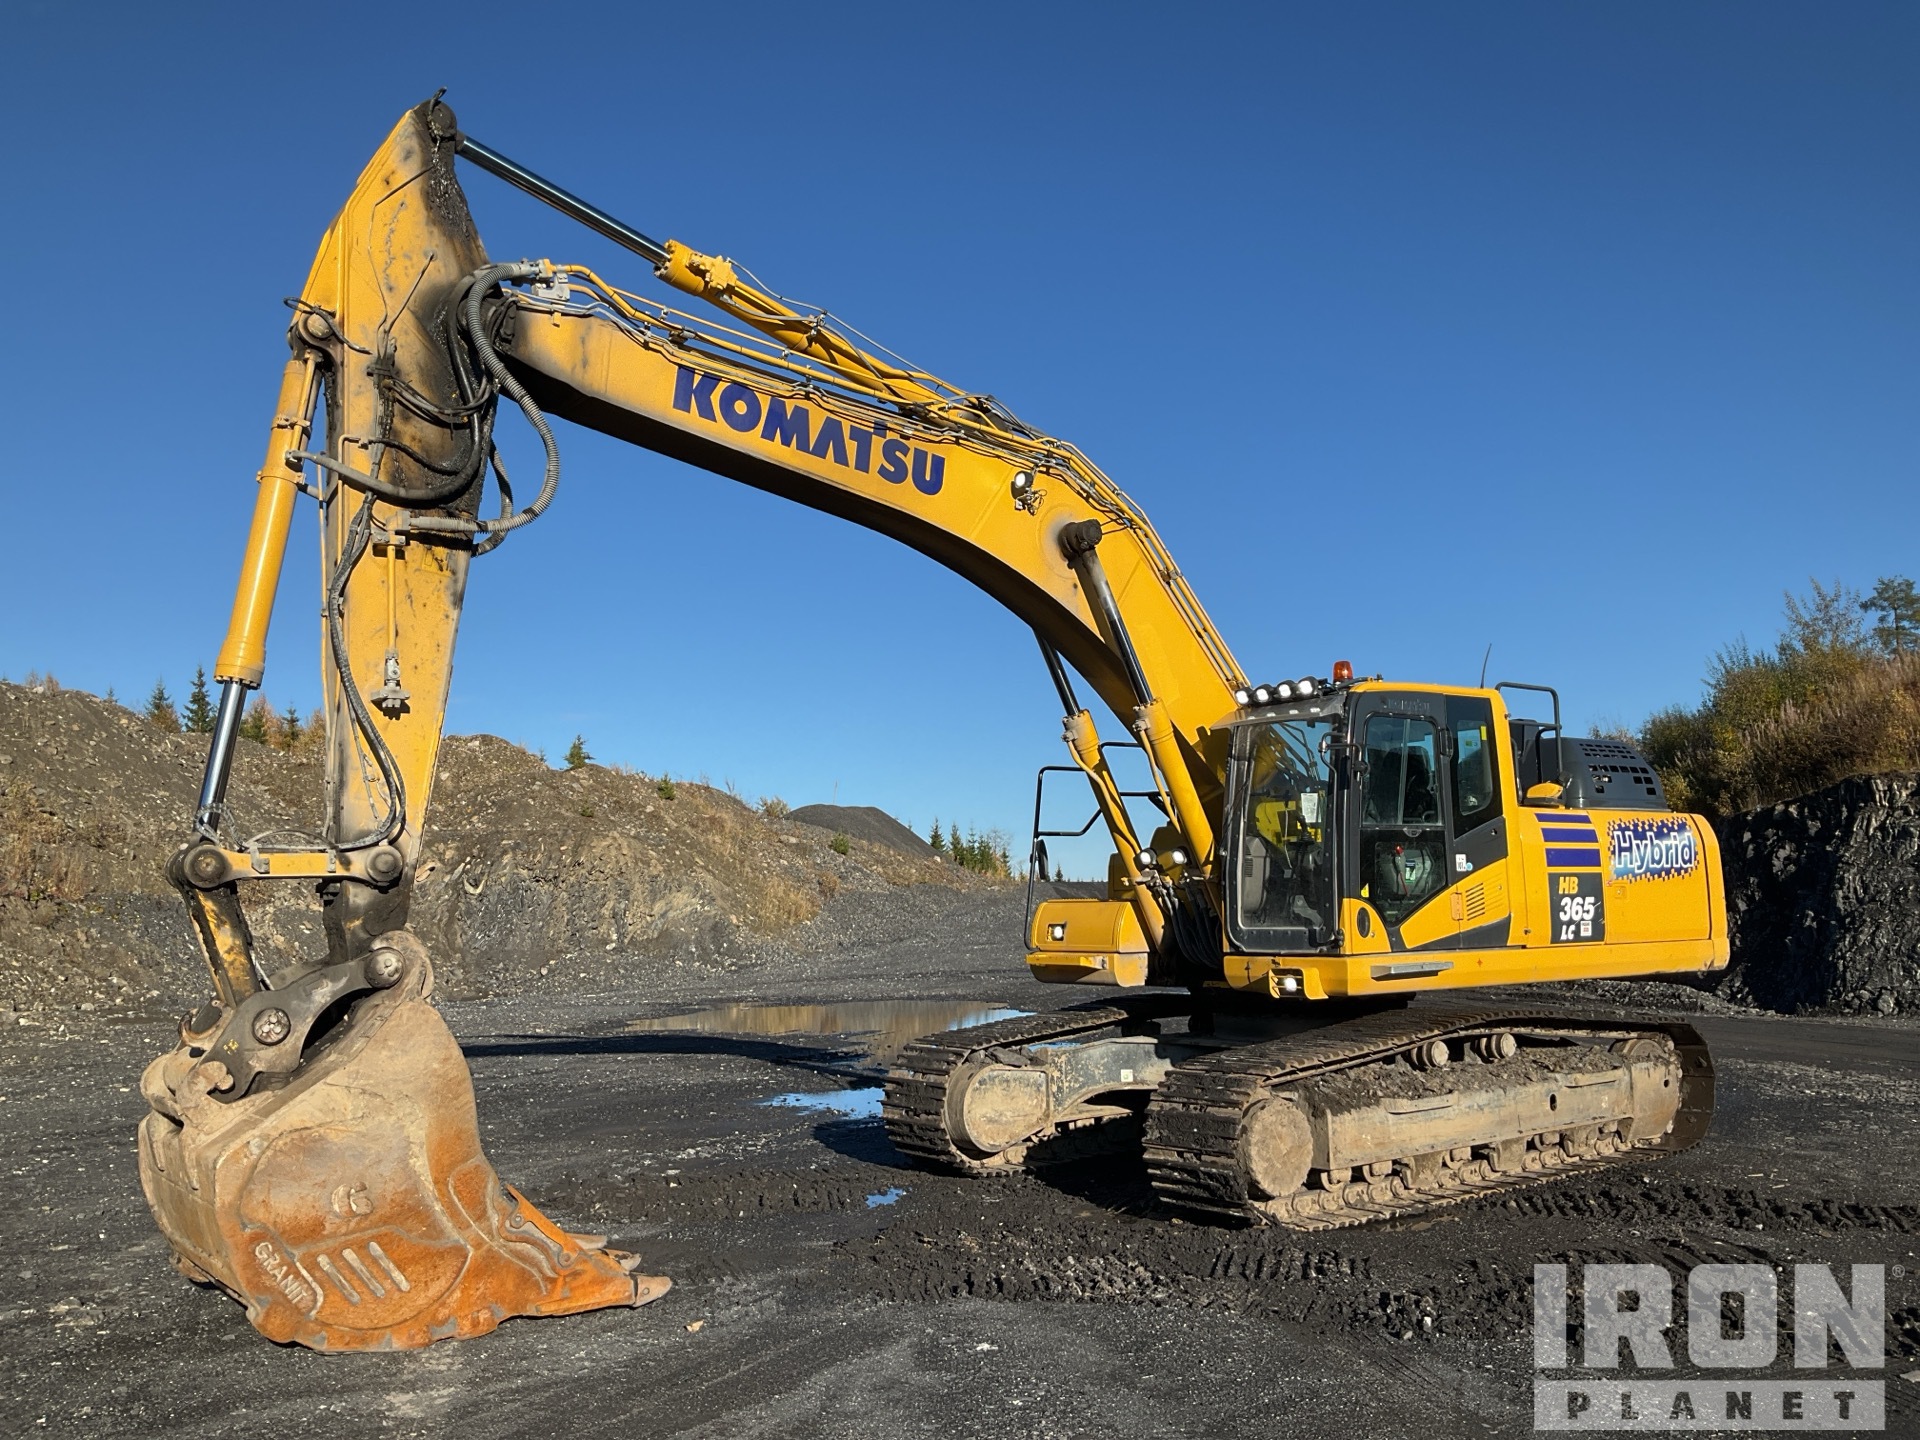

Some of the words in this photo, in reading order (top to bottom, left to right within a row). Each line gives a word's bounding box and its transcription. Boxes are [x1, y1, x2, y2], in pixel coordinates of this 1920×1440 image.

[672, 365, 945, 495] KOMATSU
[1613, 831, 1695, 871] Hybrid
[1558, 876, 1579, 894] HB
[1559, 896, 1595, 921] 365
[1560, 924, 1576, 940] LC
[255, 1242, 308, 1304] GRANIT
